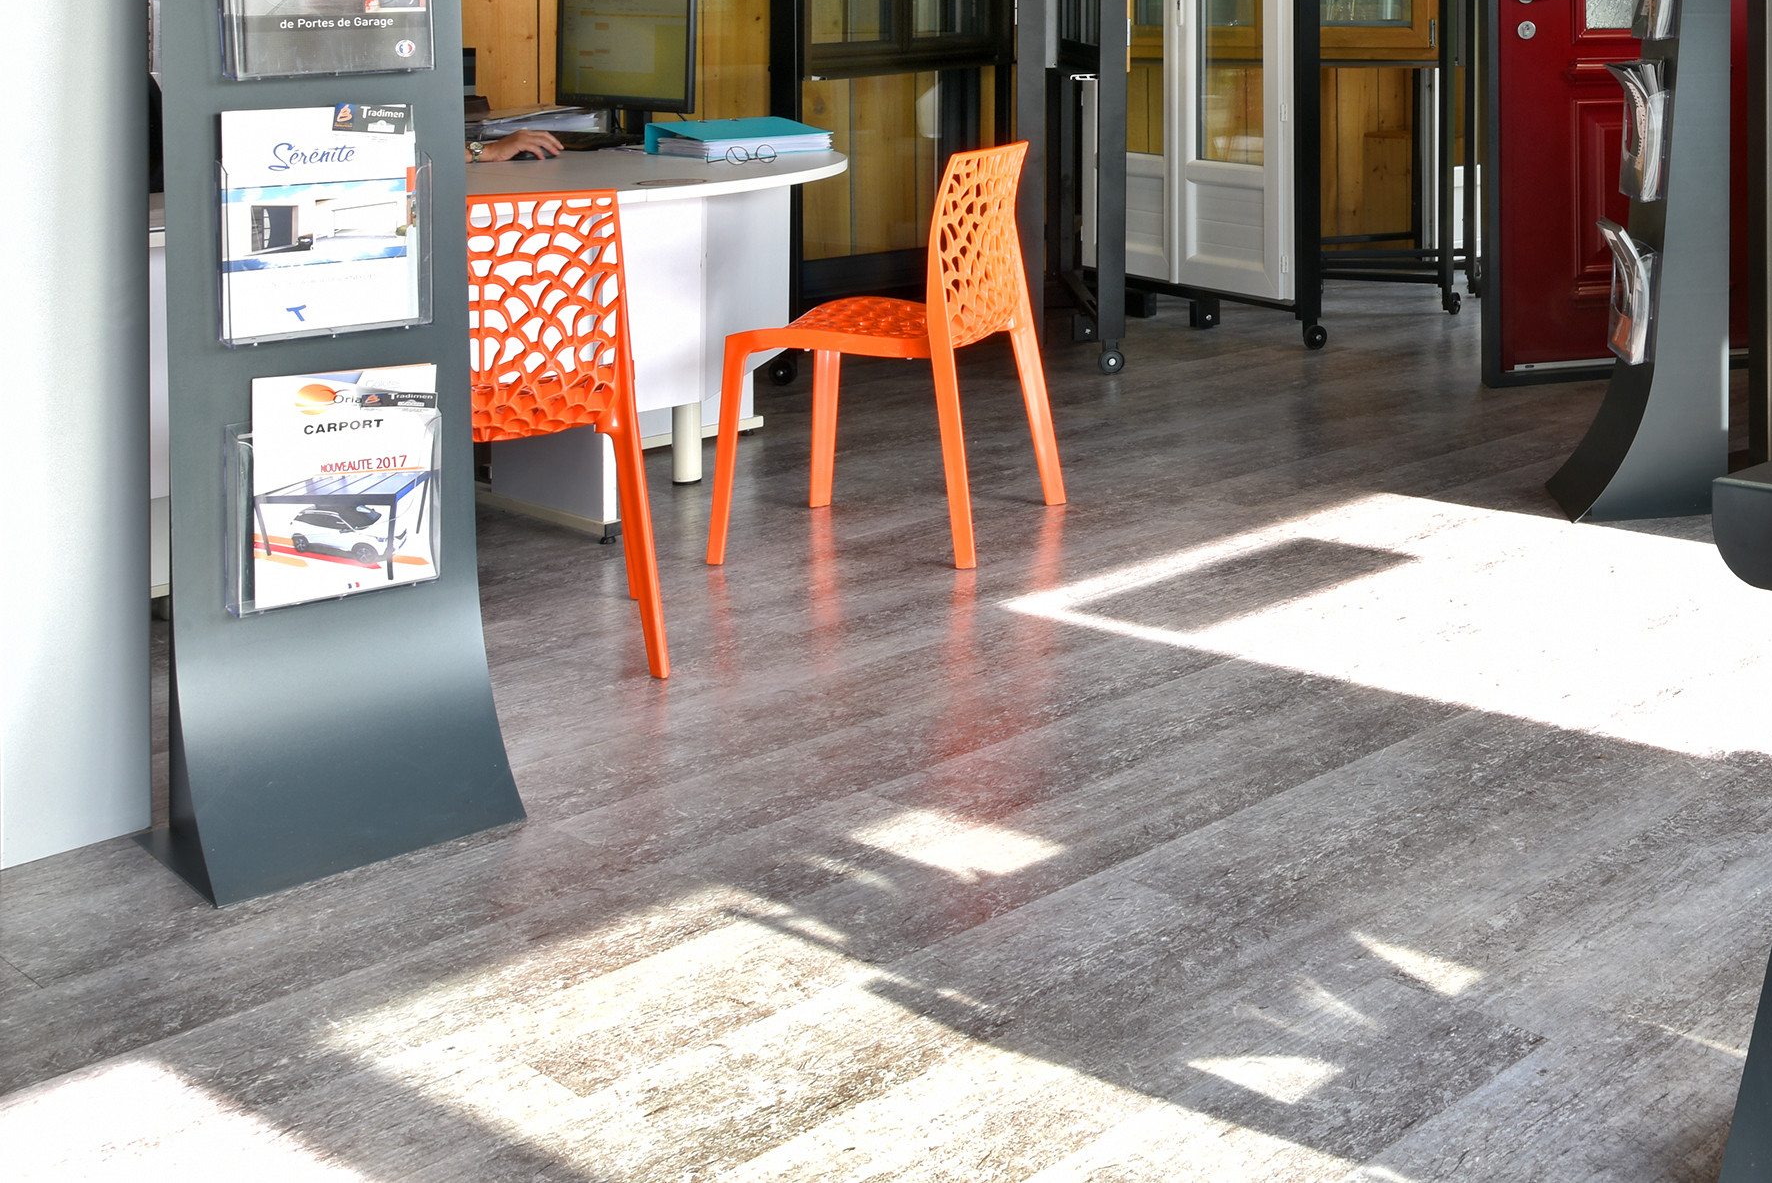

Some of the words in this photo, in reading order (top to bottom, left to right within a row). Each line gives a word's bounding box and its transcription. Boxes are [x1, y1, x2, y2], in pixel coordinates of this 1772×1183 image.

[279, 19, 295, 29] de
[298, 18, 335, 29] Portes
[337, 17, 351, 28] de
[353, 17, 394, 28] Garage
[360, 105, 405, 119] Tradimen
[388, 392, 434, 400] Tradimen
[303, 418, 384, 435] CARPORT
[376, 454, 408, 470] 2017
